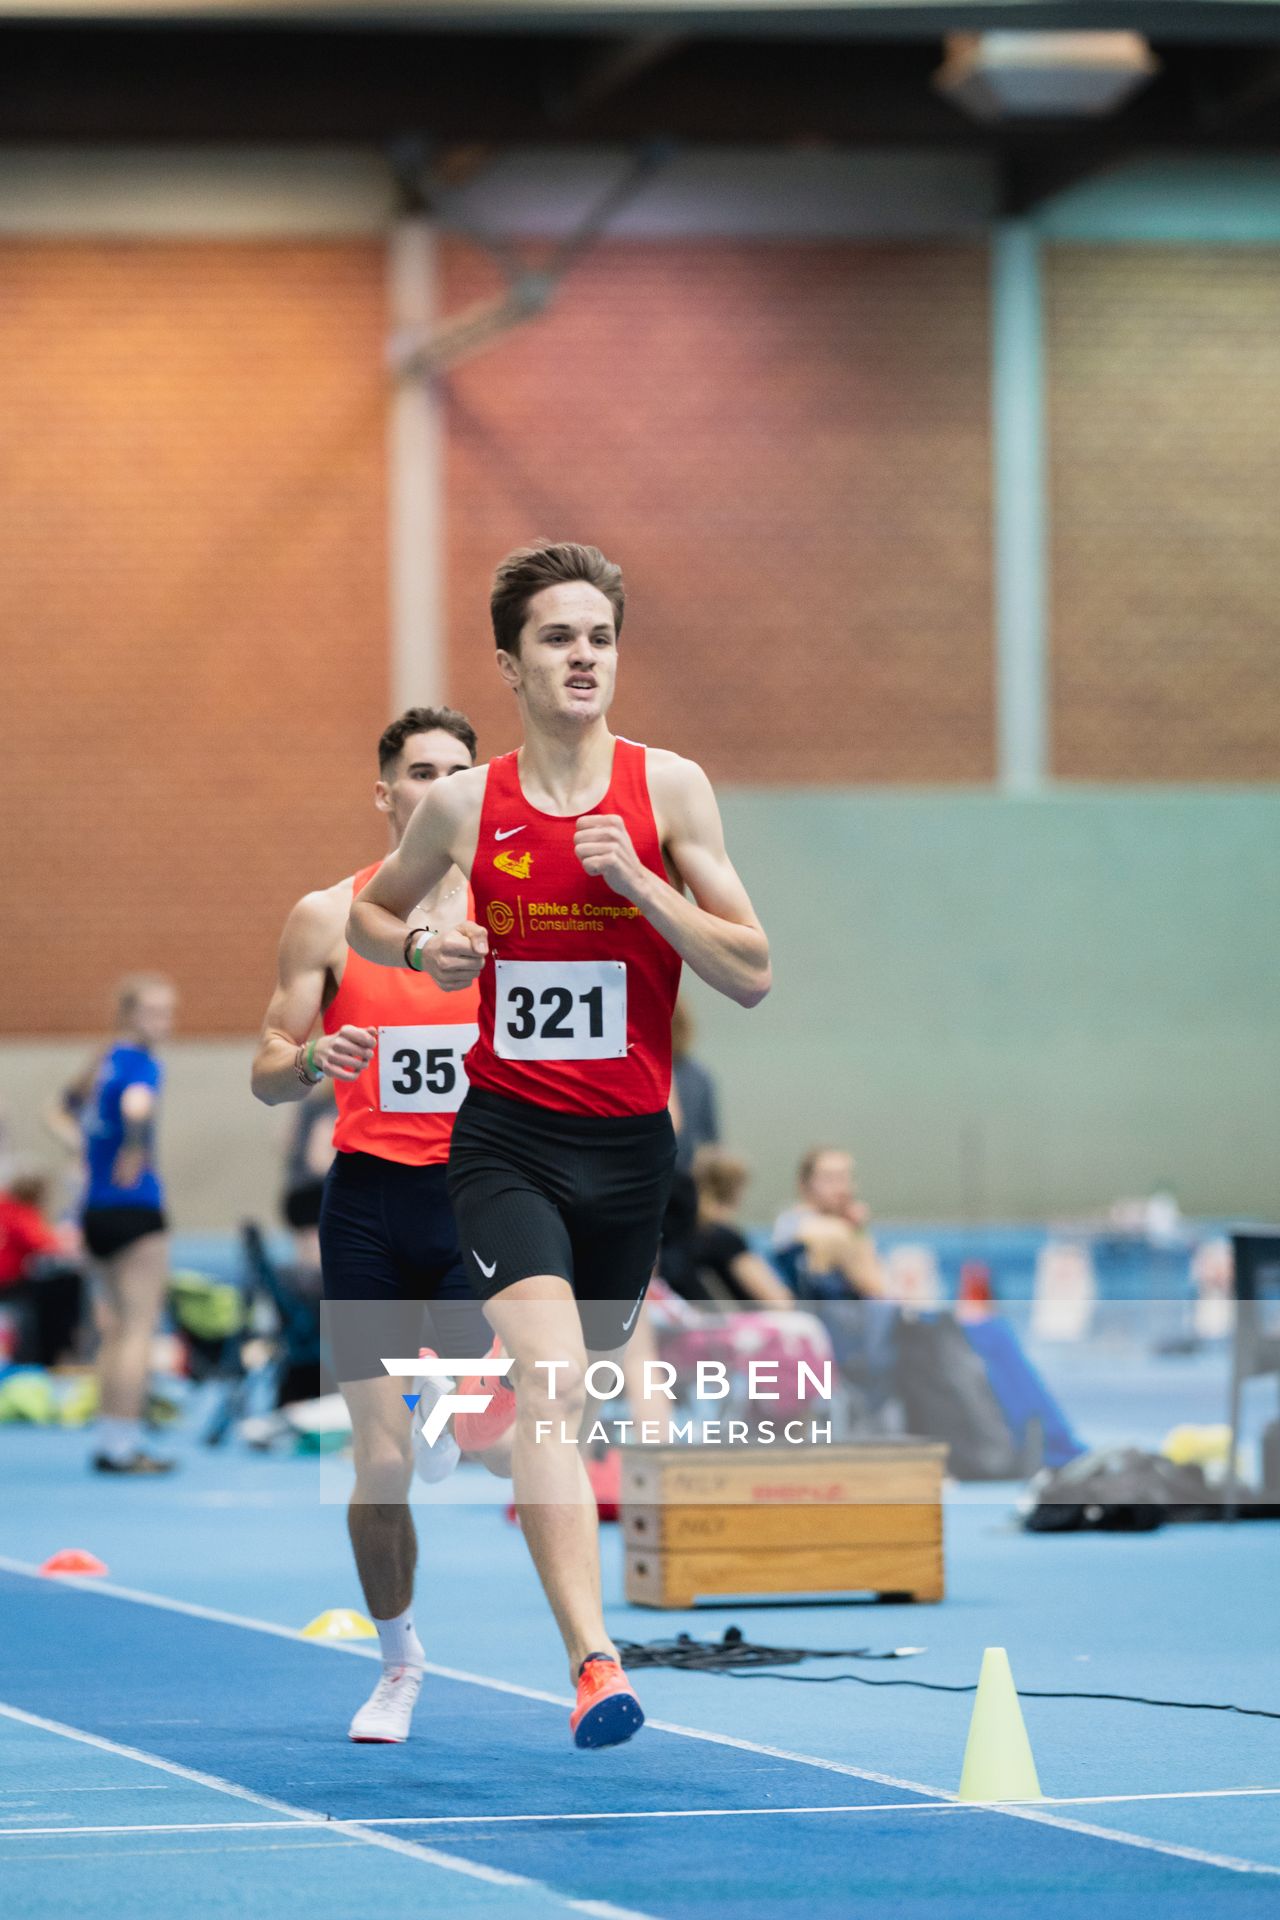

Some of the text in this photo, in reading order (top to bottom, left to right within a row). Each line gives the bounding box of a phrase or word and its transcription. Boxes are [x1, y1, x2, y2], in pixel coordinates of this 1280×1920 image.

[528, 902, 568, 916] Böhke
[571, 903, 580, 915] &
[530, 918, 604, 931] Consultants
[507, 986, 603, 1040] 321
[392, 1048, 467, 1095] 35
